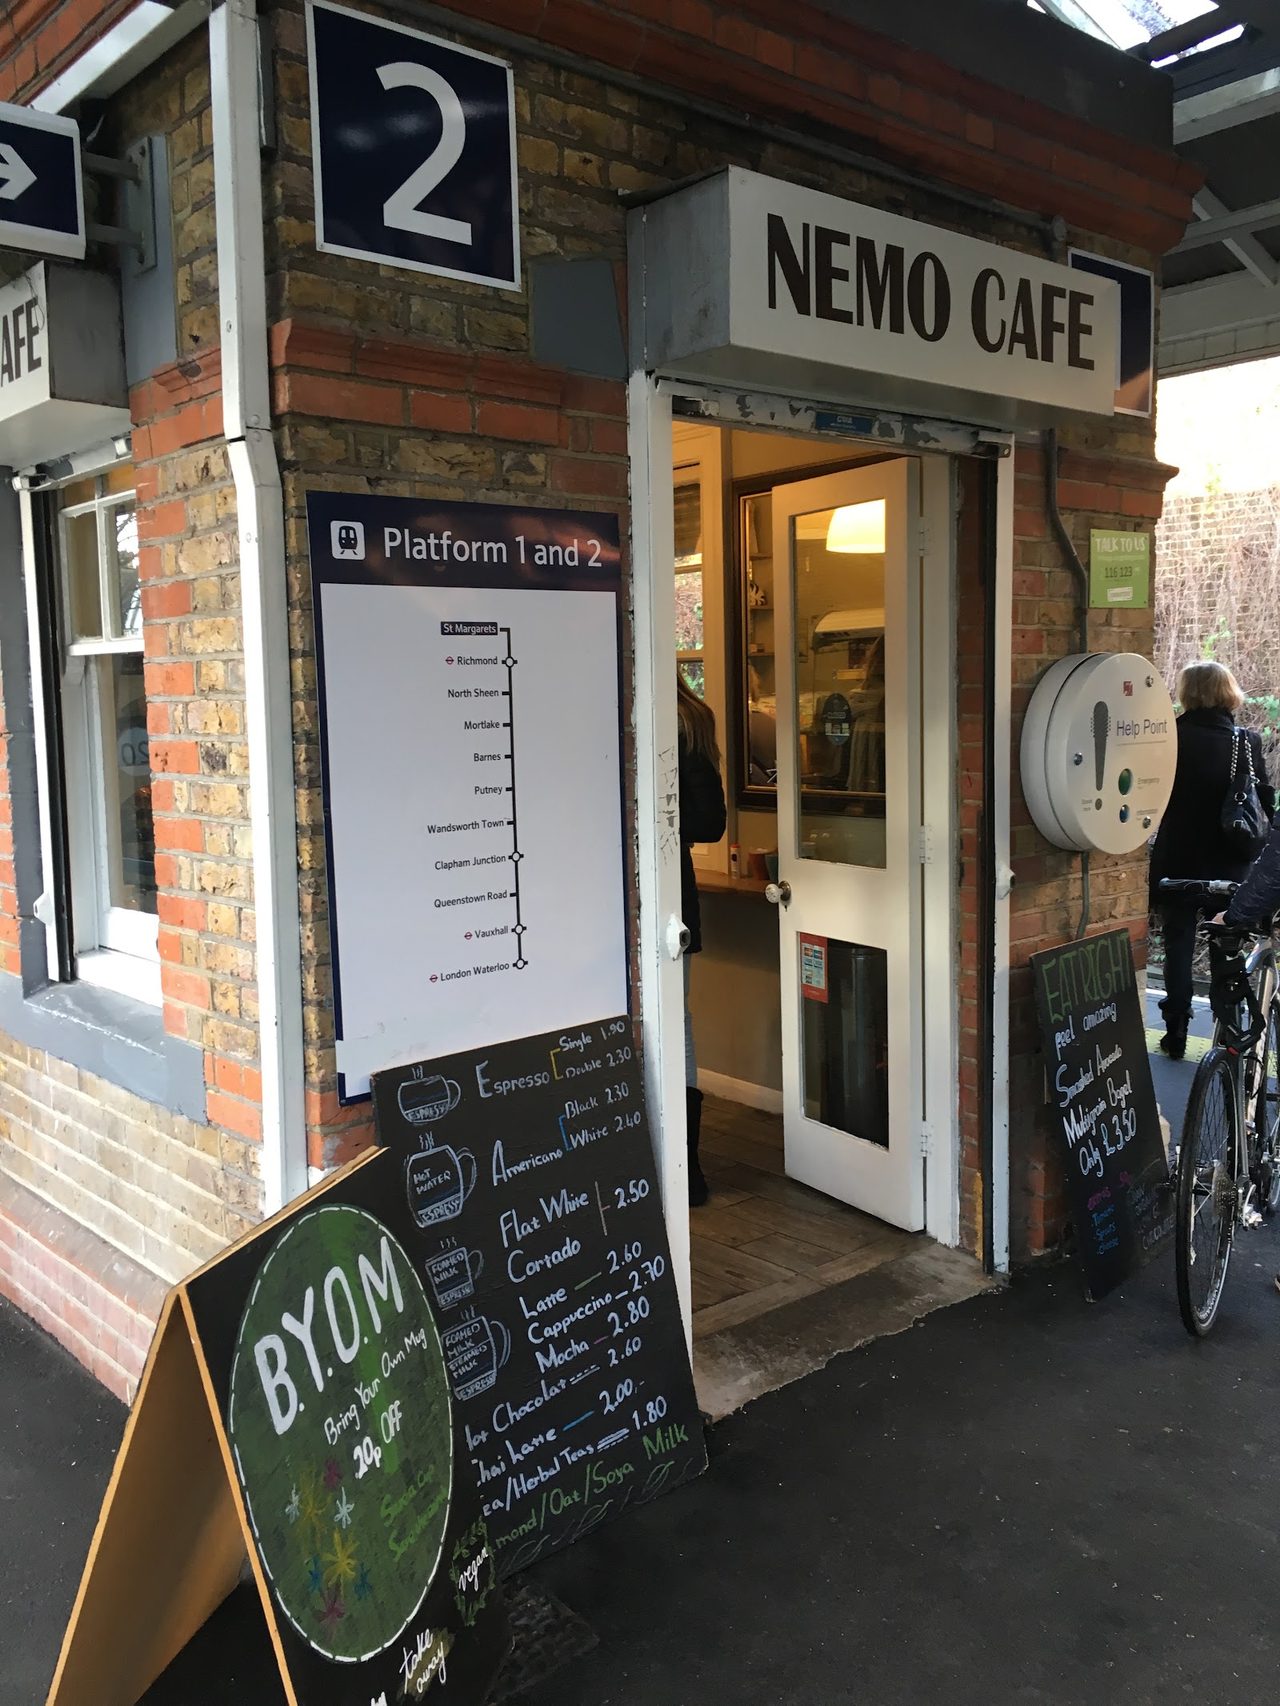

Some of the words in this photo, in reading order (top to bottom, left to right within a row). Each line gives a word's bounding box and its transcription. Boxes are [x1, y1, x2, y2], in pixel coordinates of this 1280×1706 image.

[376, 61, 473, 246] 2
[767, 212, 951, 343] NEMO
[971, 267, 1095, 371] CAFE
[384, 526, 508, 564] Platform
[514, 535, 526, 563] 1
[534, 540, 580, 566] and
[587, 539, 603, 567] 2
[1095, 537, 1118, 552] TALK
[1120, 538, 1133, 552] TO
[1134, 537, 1146, 551] US
[1119, 565, 1133, 577] 123
[443, 623, 453, 634] St
[455, 622, 497, 636] Margarets
[457, 656, 498, 666] Richmond
[448, 688, 472, 698] North
[474, 688, 499, 698] Sheen
[464, 719, 500, 730] Mortlake
[1117, 719, 1140, 738] Help
[1143, 718, 1168, 735] Point
[473, 752, 501, 762] Barnes
[474, 786, 503, 796] Putney
[427, 821, 480, 834] Wandsworth
[481, 818, 504, 829] Town
[434, 858, 471, 871] Clapham
[472, 853, 506, 866] Junction
[434, 895, 486, 908] Queenstown
[487, 890, 508, 901] Road
[474, 925, 509, 939] Vauxhall
[440, 969, 472, 982] London
[473, 962, 510, 976] Waterloo
[1041, 951, 1079, 1025] EAT
[1079, 931, 1131, 1003] RIGHT
[1082, 1001, 1118, 1033] amazing
[559, 1032, 593, 1053] Single
[600, 1020, 626, 1041] 1.90
[475, 1059, 550, 1099] Espresso
[565, 1060, 603, 1079] Double
[606, 1046, 632, 1066] 2.30
[564, 1096, 599, 1120] Black
[604, 1081, 630, 1104] 2.30
[1106, 1068, 1134, 1110] Bagel
[570, 1123, 609, 1149] White
[614, 1111, 642, 1133] 2.40
[492, 1139, 563, 1187] Americano
[1079, 1138, 1104, 1178] Only
[416, 1169, 451, 1195] WATER
[499, 1208, 542, 1249] Flat
[538, 1188, 590, 1224] White
[614, 1178, 650, 1210] 2.50
[433, 1267, 459, 1285] MILK
[506, 1236, 582, 1284] Cortado
[518, 1287, 568, 1320] Latte
[606, 1241, 642, 1275] 2.60
[527, 1292, 612, 1345] Cappuccino
[628, 1255, 665, 1293] 2.70
[445, 1323, 480, 1348] FOAMED
[447, 1338, 475, 1358] MILK
[534, 1338, 590, 1374] Mocha
[607, 1295, 650, 1338] 2.80
[607, 1336, 642, 1368] 2.60
[452, 1359, 478, 1379] MILK
[323, 1403, 361, 1446] Bring
[354, 1377, 382, 1411] Your
[381, 1350, 406, 1379] Own
[403, 1327, 428, 1351] Mug
[558, 1446, 595, 1466] Teas
[631, 1395, 668, 1431] 1.80
[641, 1422, 690, 1461] Milk
[458, 1546, 490, 1592] vegan
[399, 1628, 434, 1695] take
[416, 1640, 447, 1694] away
